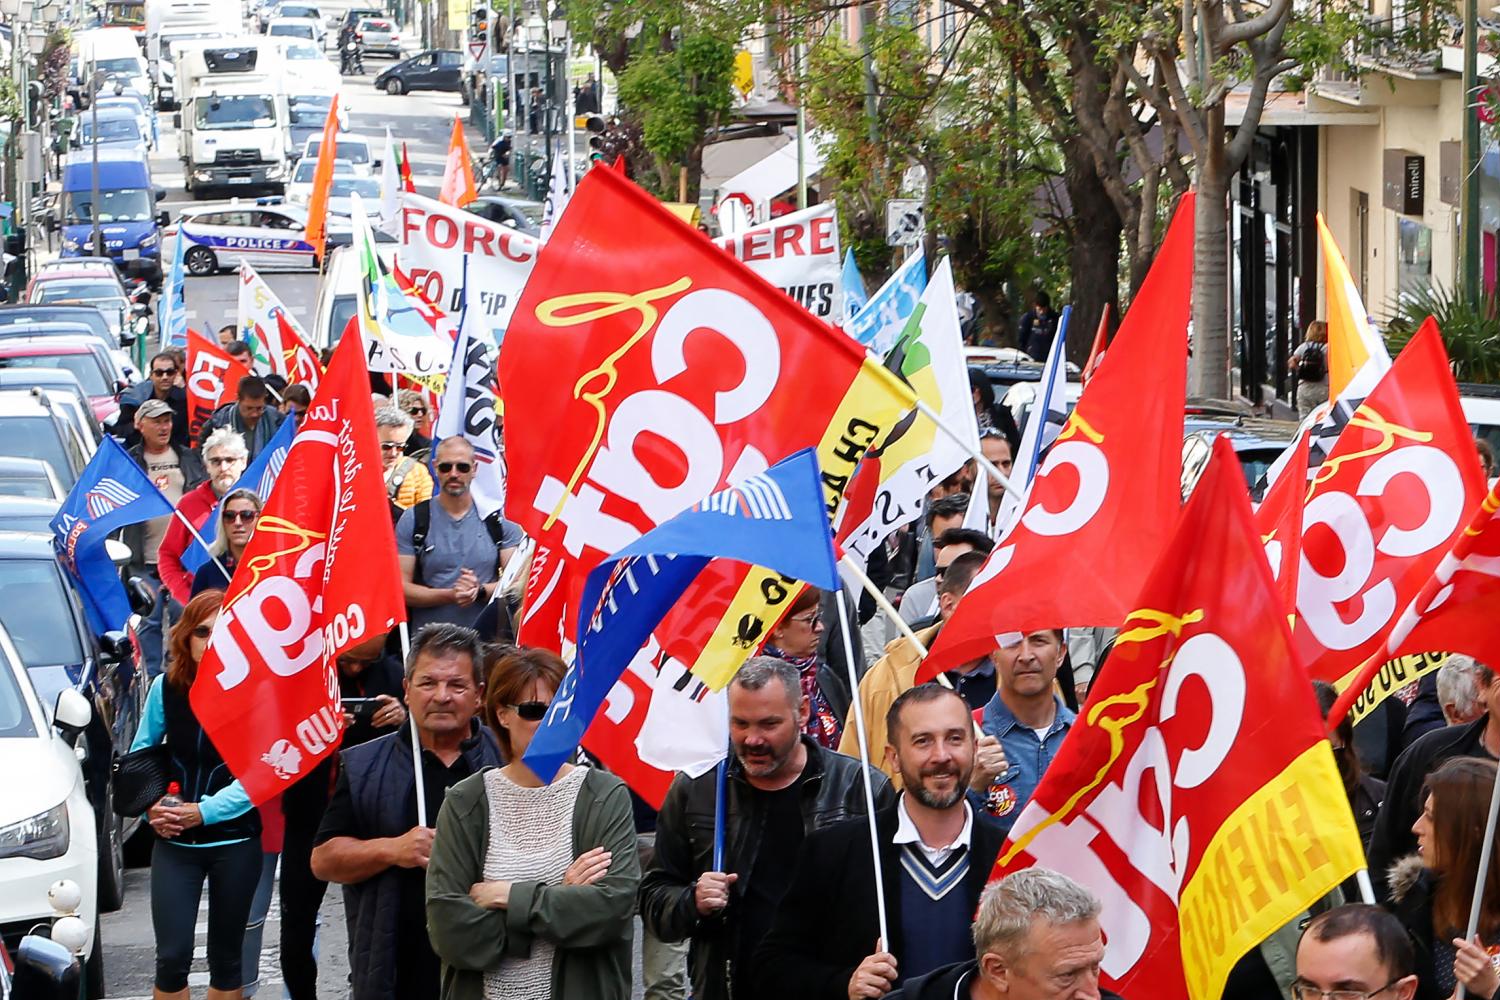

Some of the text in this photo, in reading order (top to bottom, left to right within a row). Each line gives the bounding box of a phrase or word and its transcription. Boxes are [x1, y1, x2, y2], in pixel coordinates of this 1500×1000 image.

[1408, 160, 1420, 198] minelli
[226, 236, 282, 249] POLICE
[402, 207, 545, 264] FORC
[989, 787, 1010, 803] cgt
